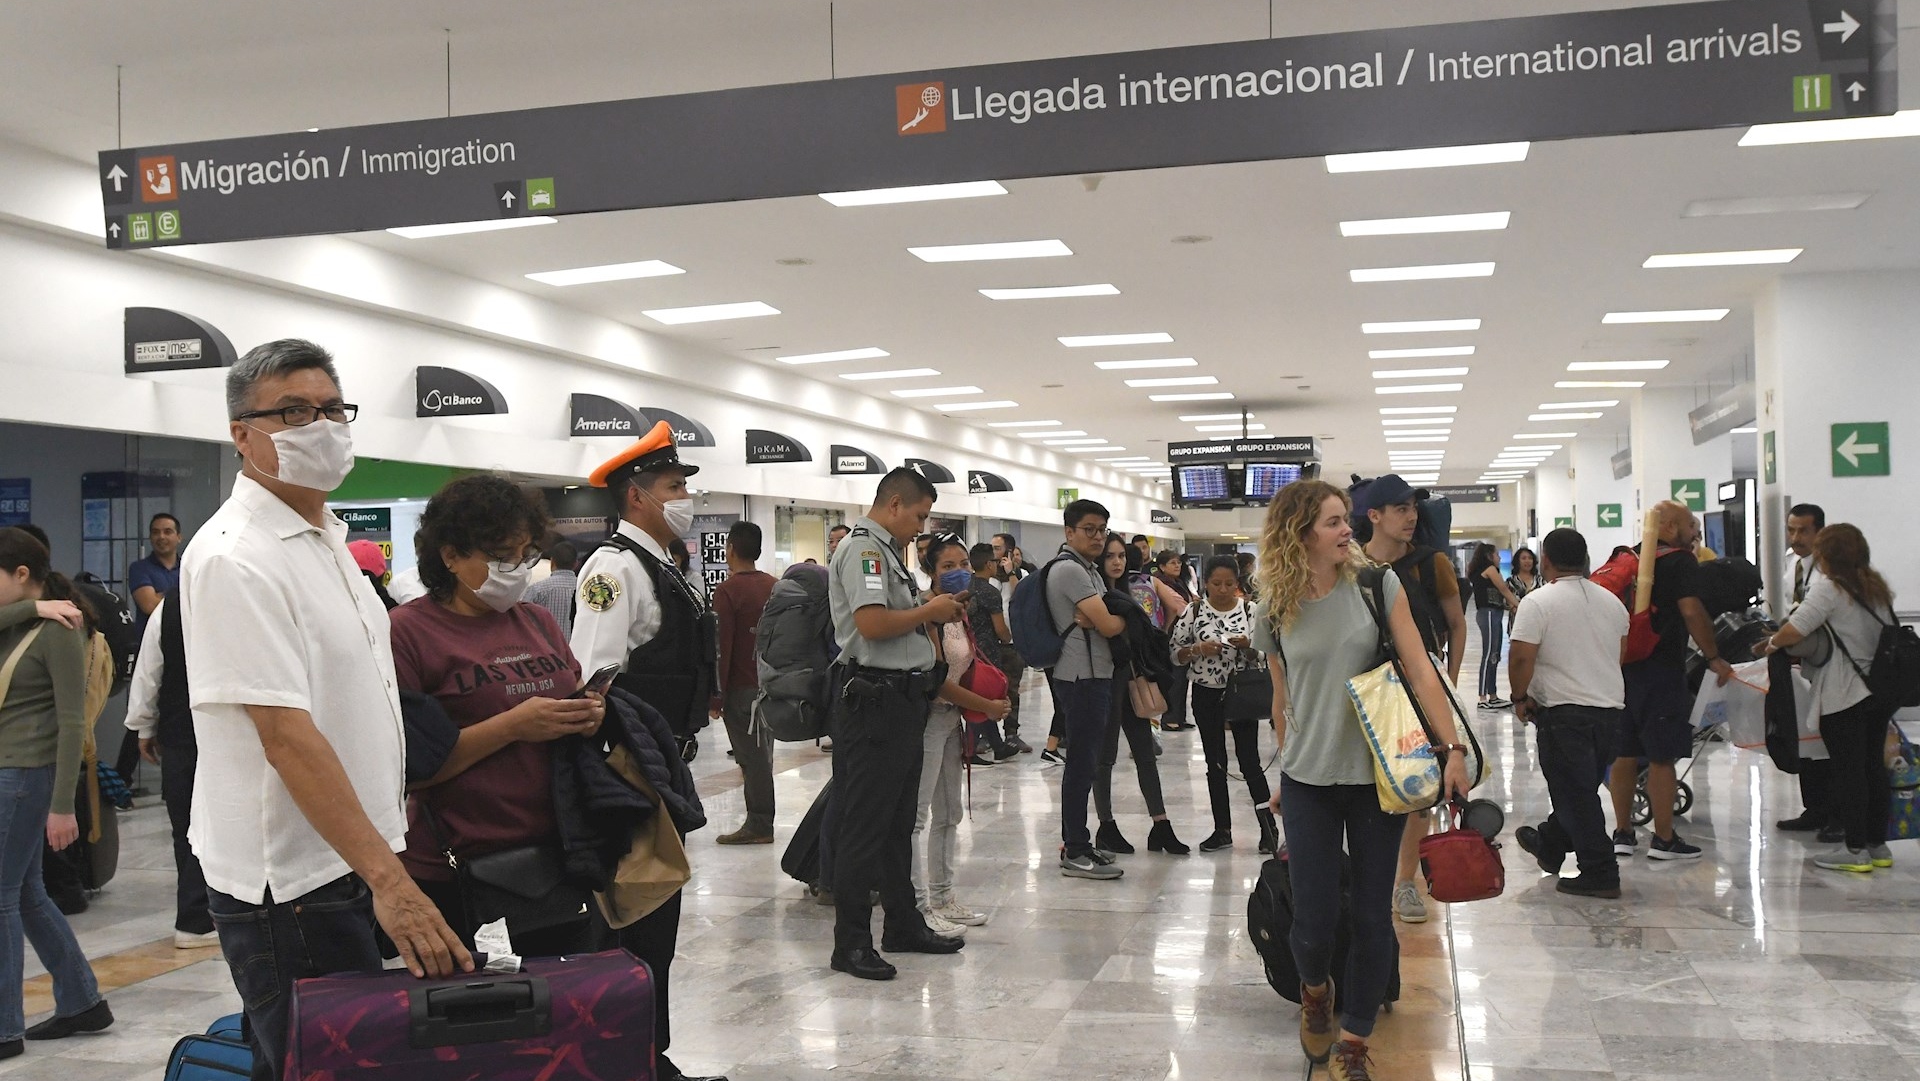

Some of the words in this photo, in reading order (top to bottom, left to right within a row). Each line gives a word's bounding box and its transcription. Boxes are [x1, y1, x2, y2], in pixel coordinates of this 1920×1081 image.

[951, 77, 1106, 124] Llegada
[1119, 53, 1384, 107] internacional
[1396, 48, 1415, 86] /
[1428, 35, 1652, 82] International
[1667, 23, 1802, 63] arrivals
[180, 151, 330, 195] Migración
[338, 145, 351, 177] /
[362, 138, 516, 178] Immigration
[143, 345, 159, 354] FOX
[442, 393, 483, 406] CIBanco
[575, 416, 631, 431] America
[674, 429, 697, 442] rica
[1170, 448, 1192, 456] GRUPO
[1192, 445, 1232, 455] EXPANSION
[1236, 444, 1264, 452] GRUPO
[1265, 442, 1311, 451] EXPANSION
[342, 512, 378, 522] CIBanco
[1153, 515, 1172, 523] Hertz
[701, 549, 727, 563] 21.0
[494, 653, 532, 664] Authentic
[454, 663, 508, 694] LAS
[507, 653, 569, 680] VEGA
[539, 678, 555, 690] USA
